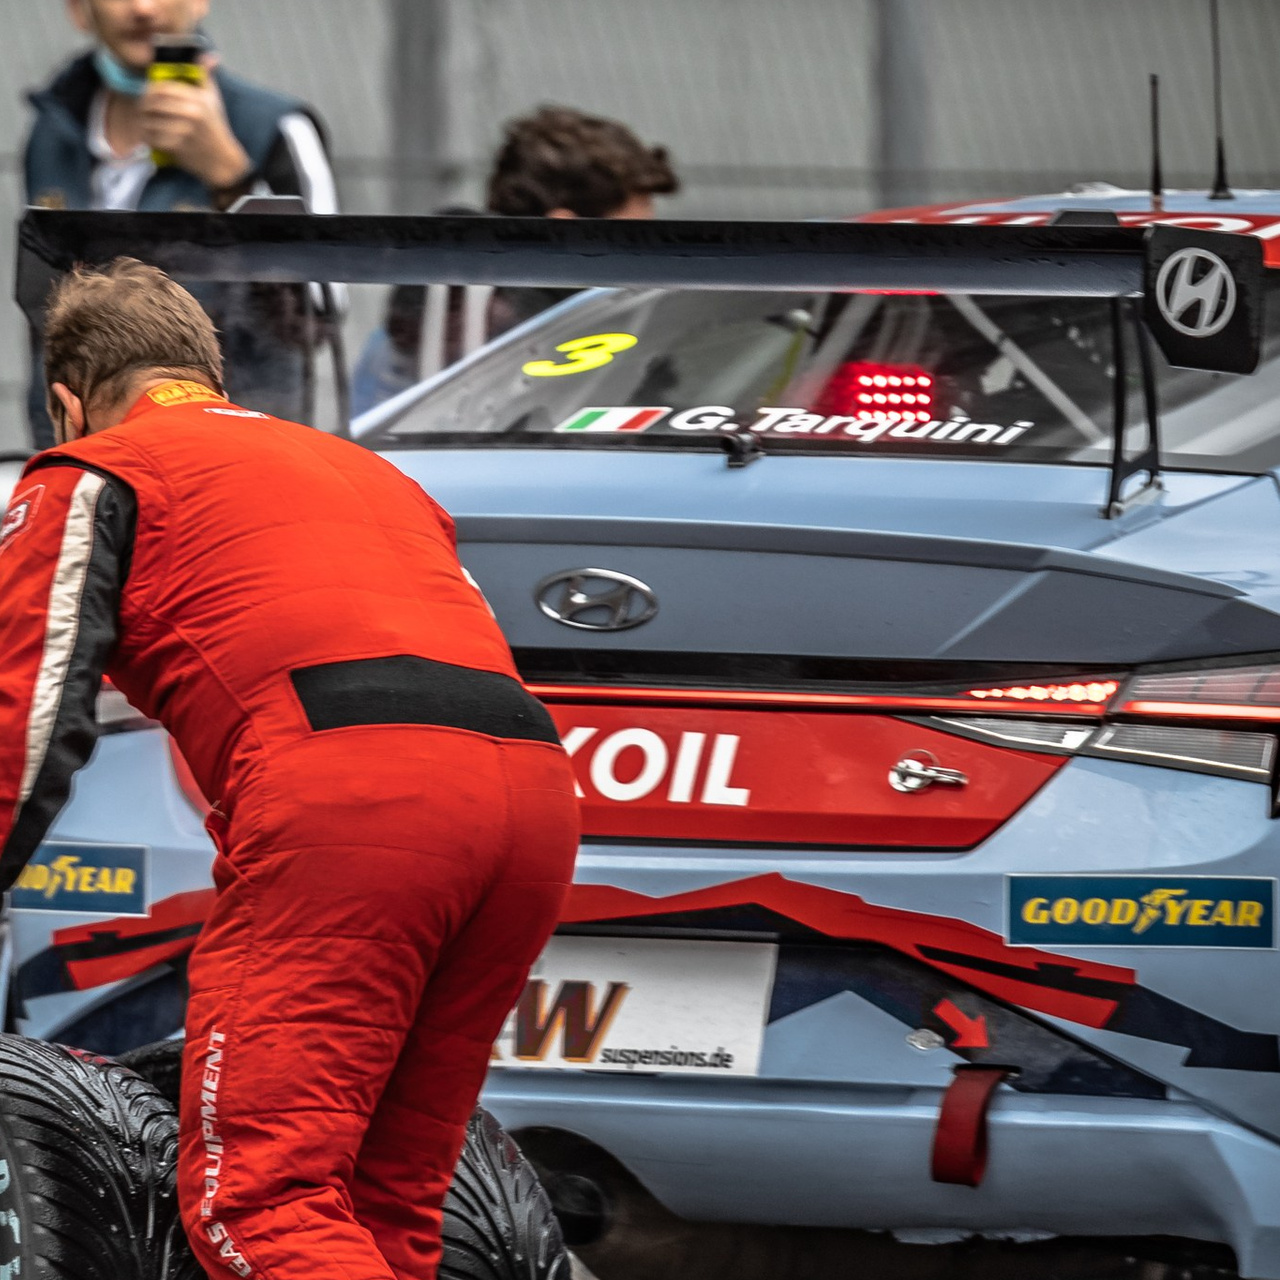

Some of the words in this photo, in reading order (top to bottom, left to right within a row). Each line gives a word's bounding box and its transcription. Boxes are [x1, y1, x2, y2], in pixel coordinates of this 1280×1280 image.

[523, 333, 638, 377] 3
[669, 405, 739, 432] G.
[749, 406, 1035, 444] Tarquini
[1022, 891, 1264, 932] GOODYEAR
[491, 978, 632, 1063] W
[599, 1045, 735, 1069] suspensions.de
[200, 1025, 227, 1217] EQUIPMENT
[206, 1221, 252, 1278] GAS
